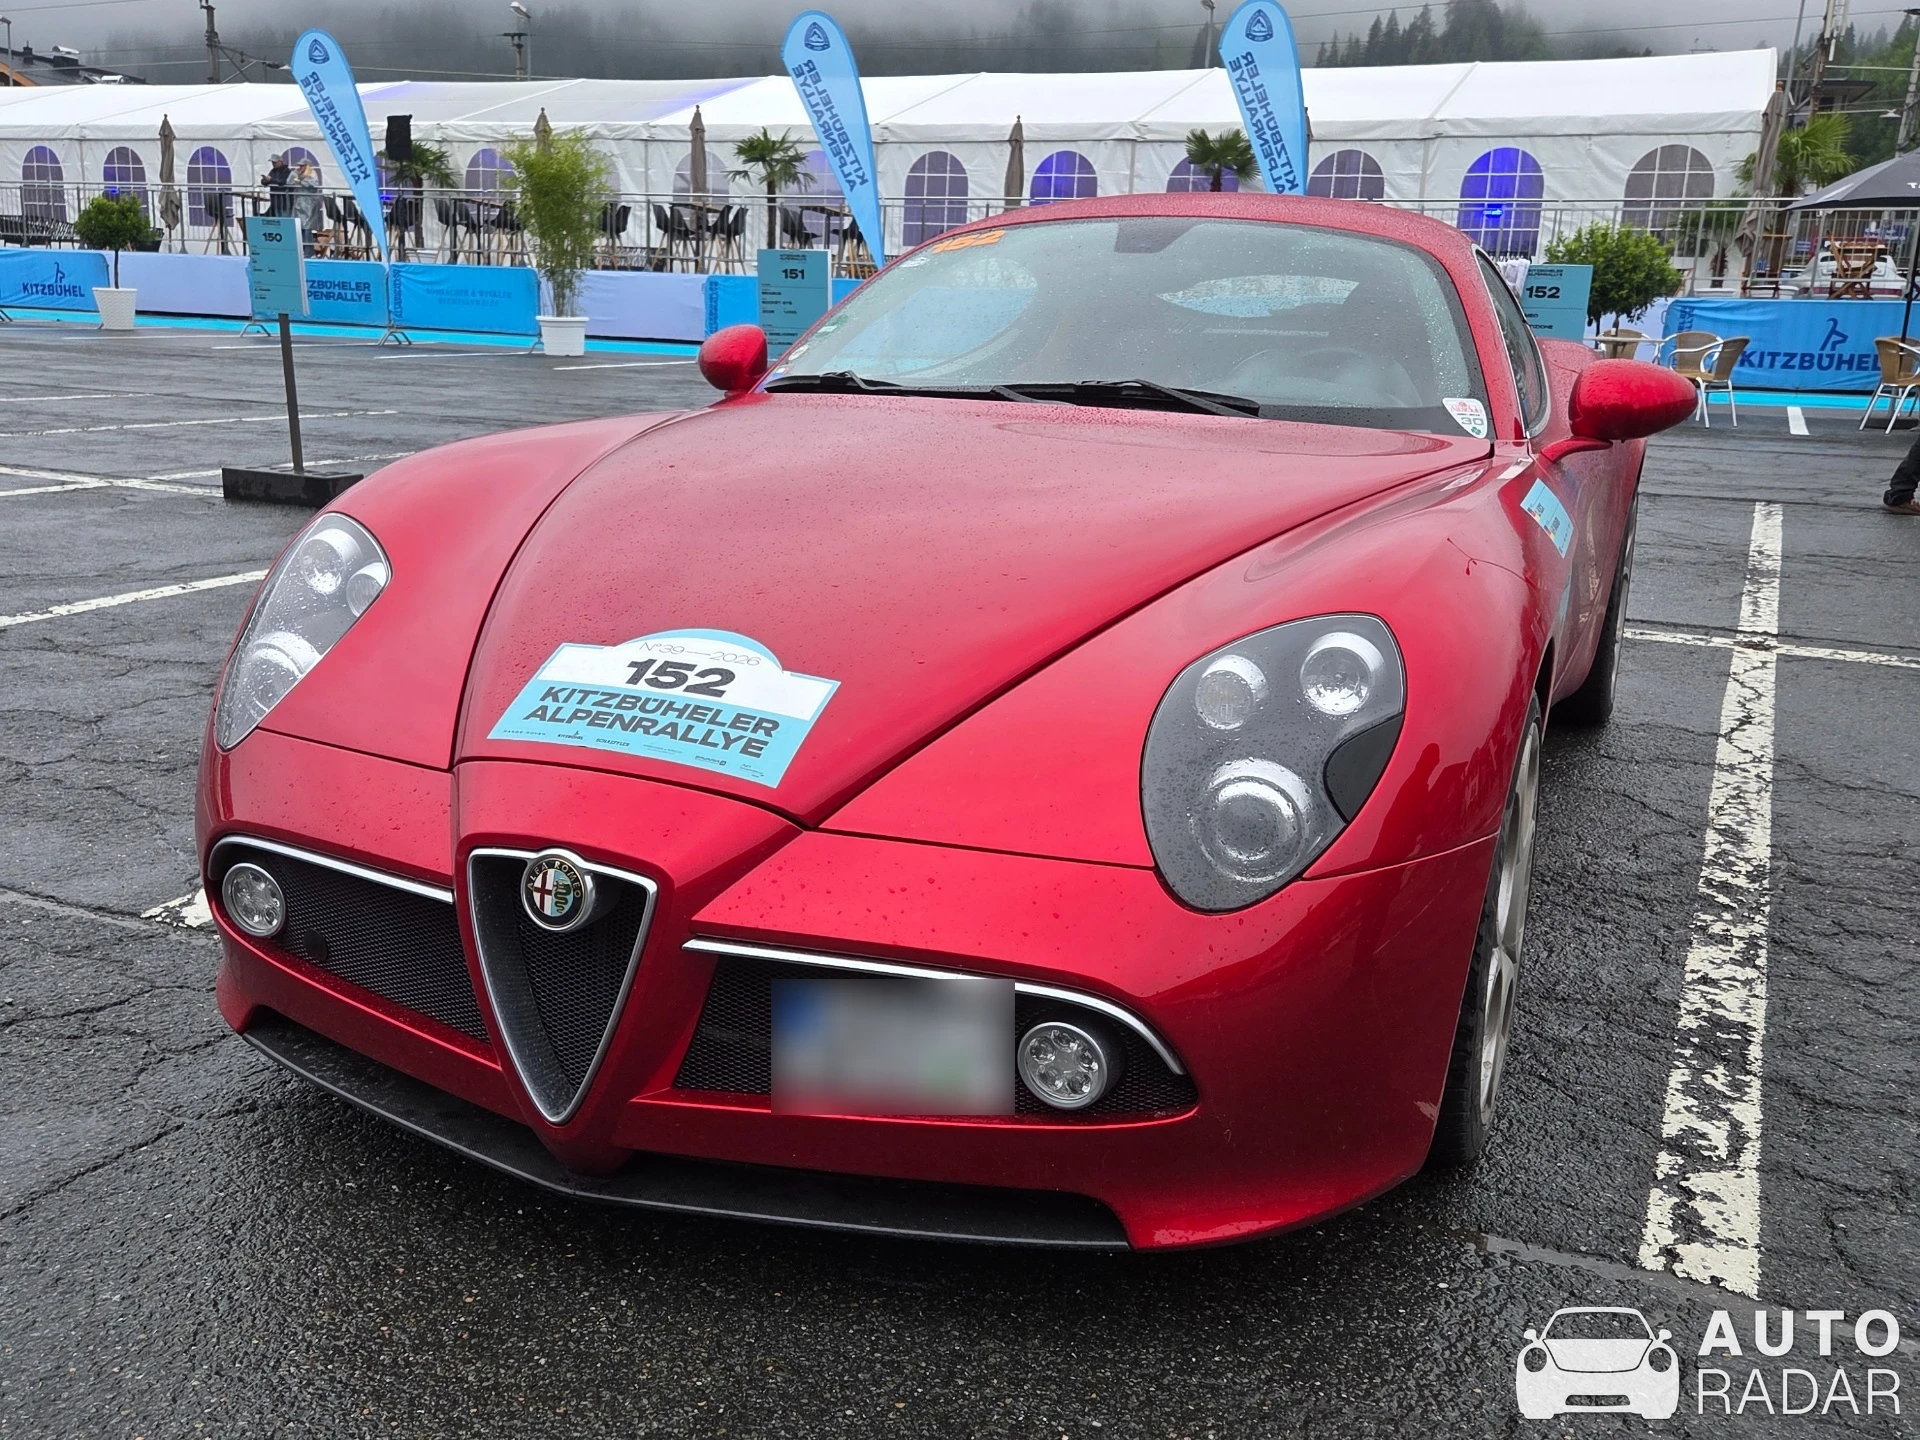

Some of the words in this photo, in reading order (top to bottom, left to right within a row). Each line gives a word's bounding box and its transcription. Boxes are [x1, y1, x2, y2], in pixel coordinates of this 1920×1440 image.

[262, 232, 283, 243] 150
[932, 229, 1007, 255] 152
[782, 268, 805, 280] 151
[22, 282, 86, 298] KITZBÜHEL
[1525, 285, 1561, 299] 152
[1738, 350, 1882, 372] KITZBÜHEL
[1460, 416, 1485, 426] 30
[625, 658, 736, 698] 152
[539, 686, 780, 738] KITZBÜHELER
[522, 705, 770, 758] ALPENRALLYE
[526, 862, 549, 891] ALFA
[554, 860, 582, 898] ROMEO
